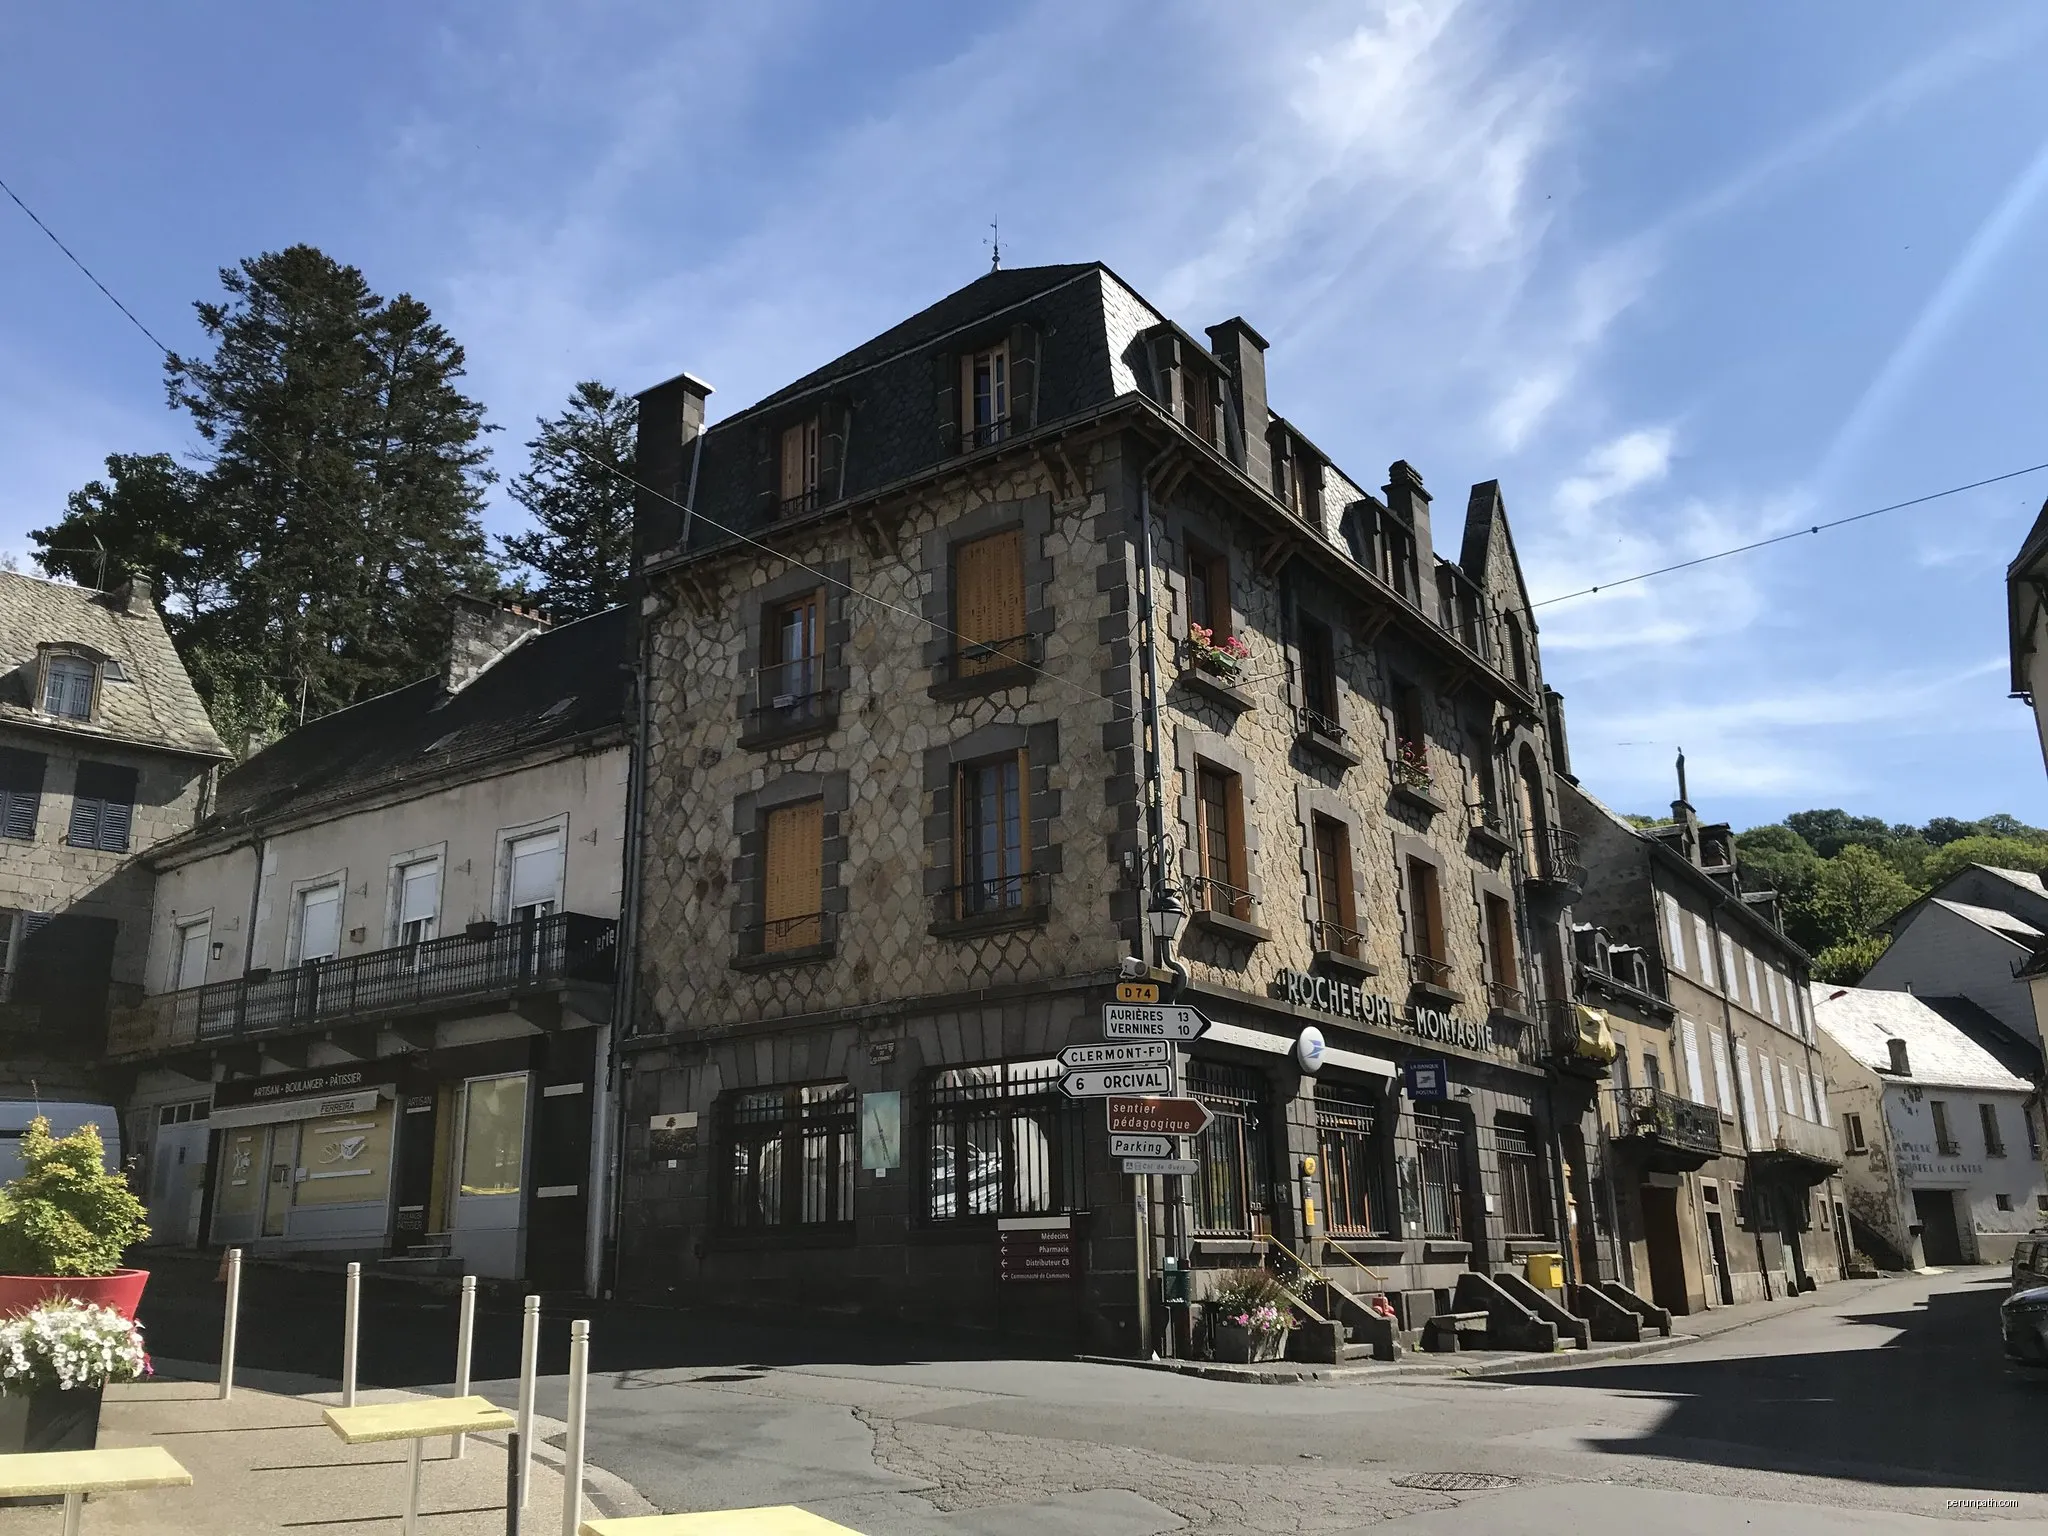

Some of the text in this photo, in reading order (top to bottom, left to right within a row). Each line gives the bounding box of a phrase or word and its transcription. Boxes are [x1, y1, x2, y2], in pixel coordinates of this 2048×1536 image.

[1124, 987, 1151, 999] D 74
[1110, 1007, 1189, 1022] AURIÈRES 13
[1286, 968, 1493, 1052] ROCHEFORT MONTAGNE
[1110, 1023, 1190, 1036] VERNINES 10
[253, 1084, 280, 1097] ARTISAN
[285, 1078, 324, 1093] BOULANGER
[1076, 1073, 1162, 1091] 6 ORCIVAL
[320, 1101, 355, 1113] FERREIRA
[1113, 1102, 1156, 1114] sentier
[1113, 1116, 1190, 1132] pédagogique
[1115, 1140, 1162, 1155] Parking
[1041, 1232, 1069, 1240] Médecins
[1039, 1245, 1069, 1253] Pharmacie
[1026, 1258, 1070, 1267] Distributeur CB
